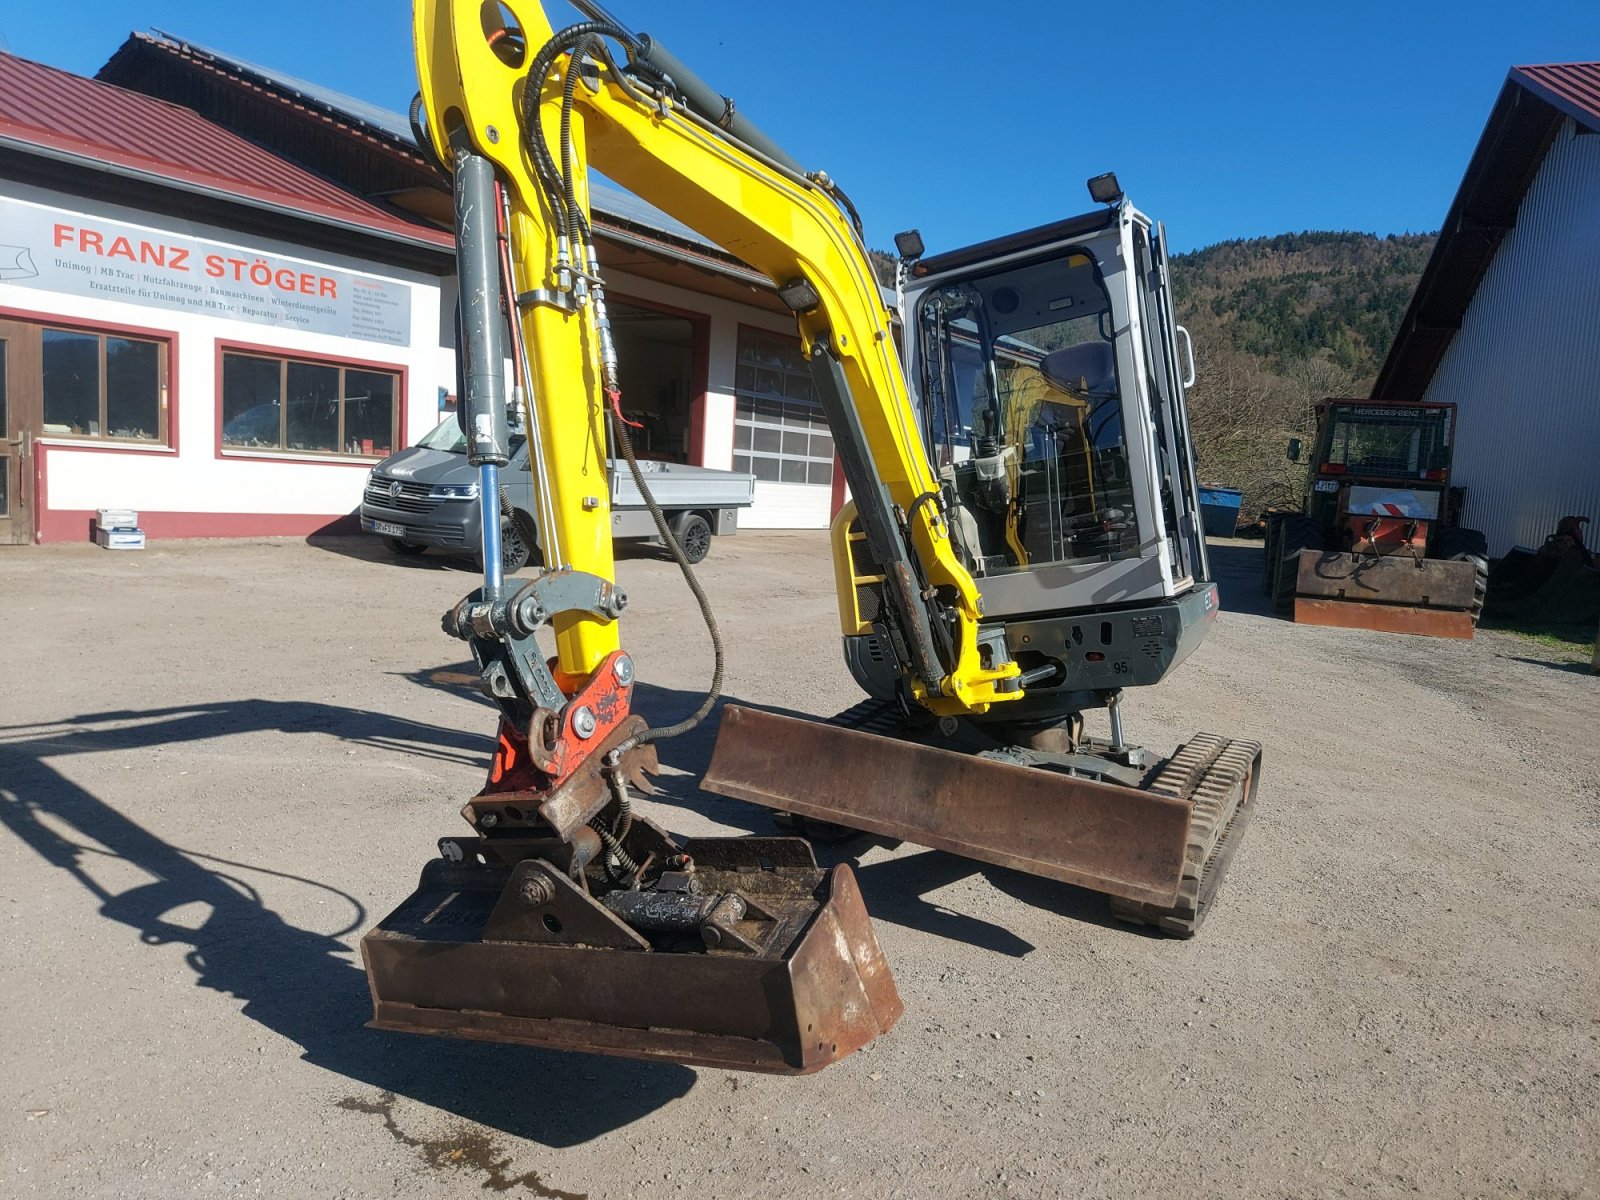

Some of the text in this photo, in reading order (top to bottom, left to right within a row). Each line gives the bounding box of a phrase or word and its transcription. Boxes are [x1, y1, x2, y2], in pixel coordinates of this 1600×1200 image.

[54, 223, 337, 299] FRANZ STÖGER
[54, 259, 91, 274] Unimog
[100, 267, 114, 277] MB
[116, 270, 134, 280] Trac
[143, 274, 203, 292] Nutzfahrzeuge
[210, 286, 265, 303] Baumaschinen
[271, 297, 337, 315] Winterdienstgeräte
[90, 281, 310, 324] Ersatzteile für Unimog und MB Trac Reparatur Service
[1354, 408, 1420, 417] MERCEDES-BENZ
[1113, 662, 1128, 674] 95
